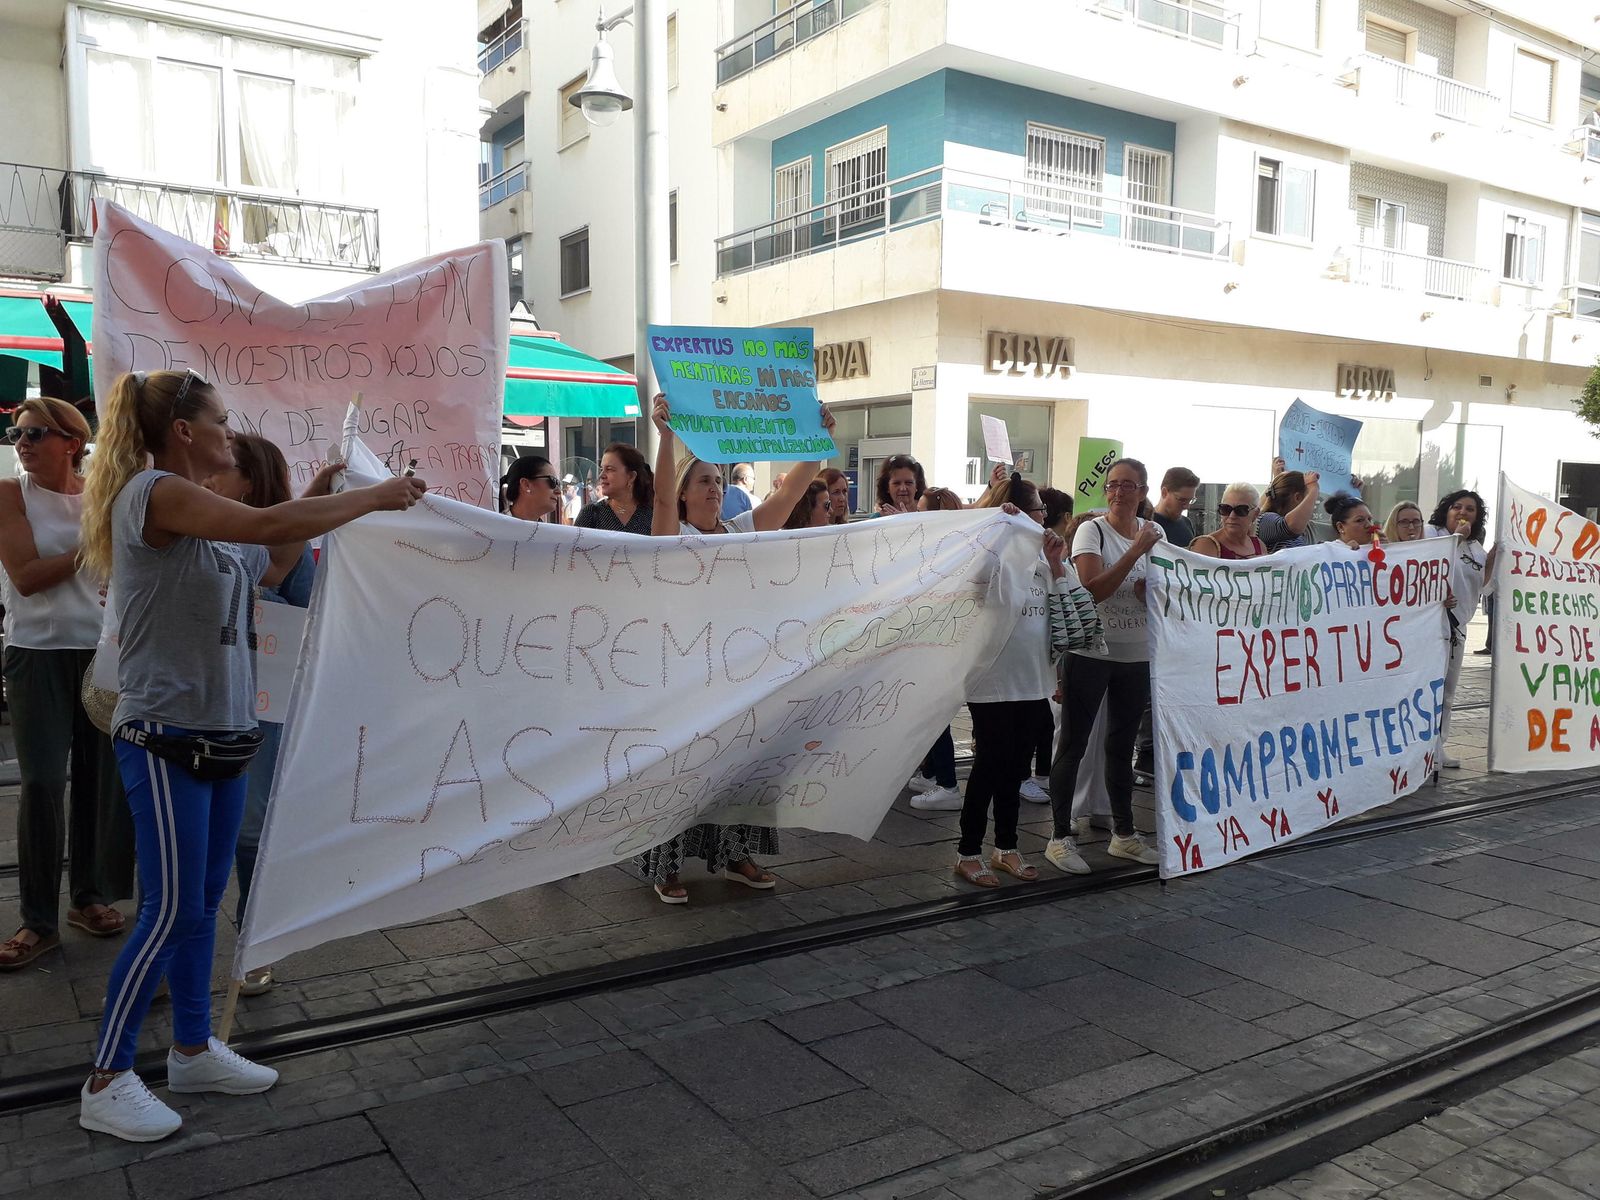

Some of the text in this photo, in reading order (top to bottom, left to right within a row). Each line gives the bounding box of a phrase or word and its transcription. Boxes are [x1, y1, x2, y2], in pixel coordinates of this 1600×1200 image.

[123, 332, 487, 385] DE NUESTROS HIJOS
[651, 336, 809, 360] EXPERTUS NO MÁS
[815, 341, 868, 383] BVA
[986, 331, 1074, 378] BBVA
[713, 389, 791, 412] ENGAÑOS
[1337, 363, 1396, 399] BBVA
[283, 407, 329, 446] DE
[1078, 450, 1116, 496] PLIEGO
[1021, 606, 1046, 617] USTO
[1150, 556, 1450, 628] TRABAJAMOS PARA COBRAR
[1512, 589, 1599, 620] DERECHAS
[407, 596, 806, 692] QUEREMOS
[1216, 615, 1404, 705] EXPERTUS
[1515, 622, 1596, 662] LOS DE
[1170, 677, 1444, 823] COMPROMETERSE
[1527, 708, 1573, 752] DE
[350, 719, 554, 827] LAS
